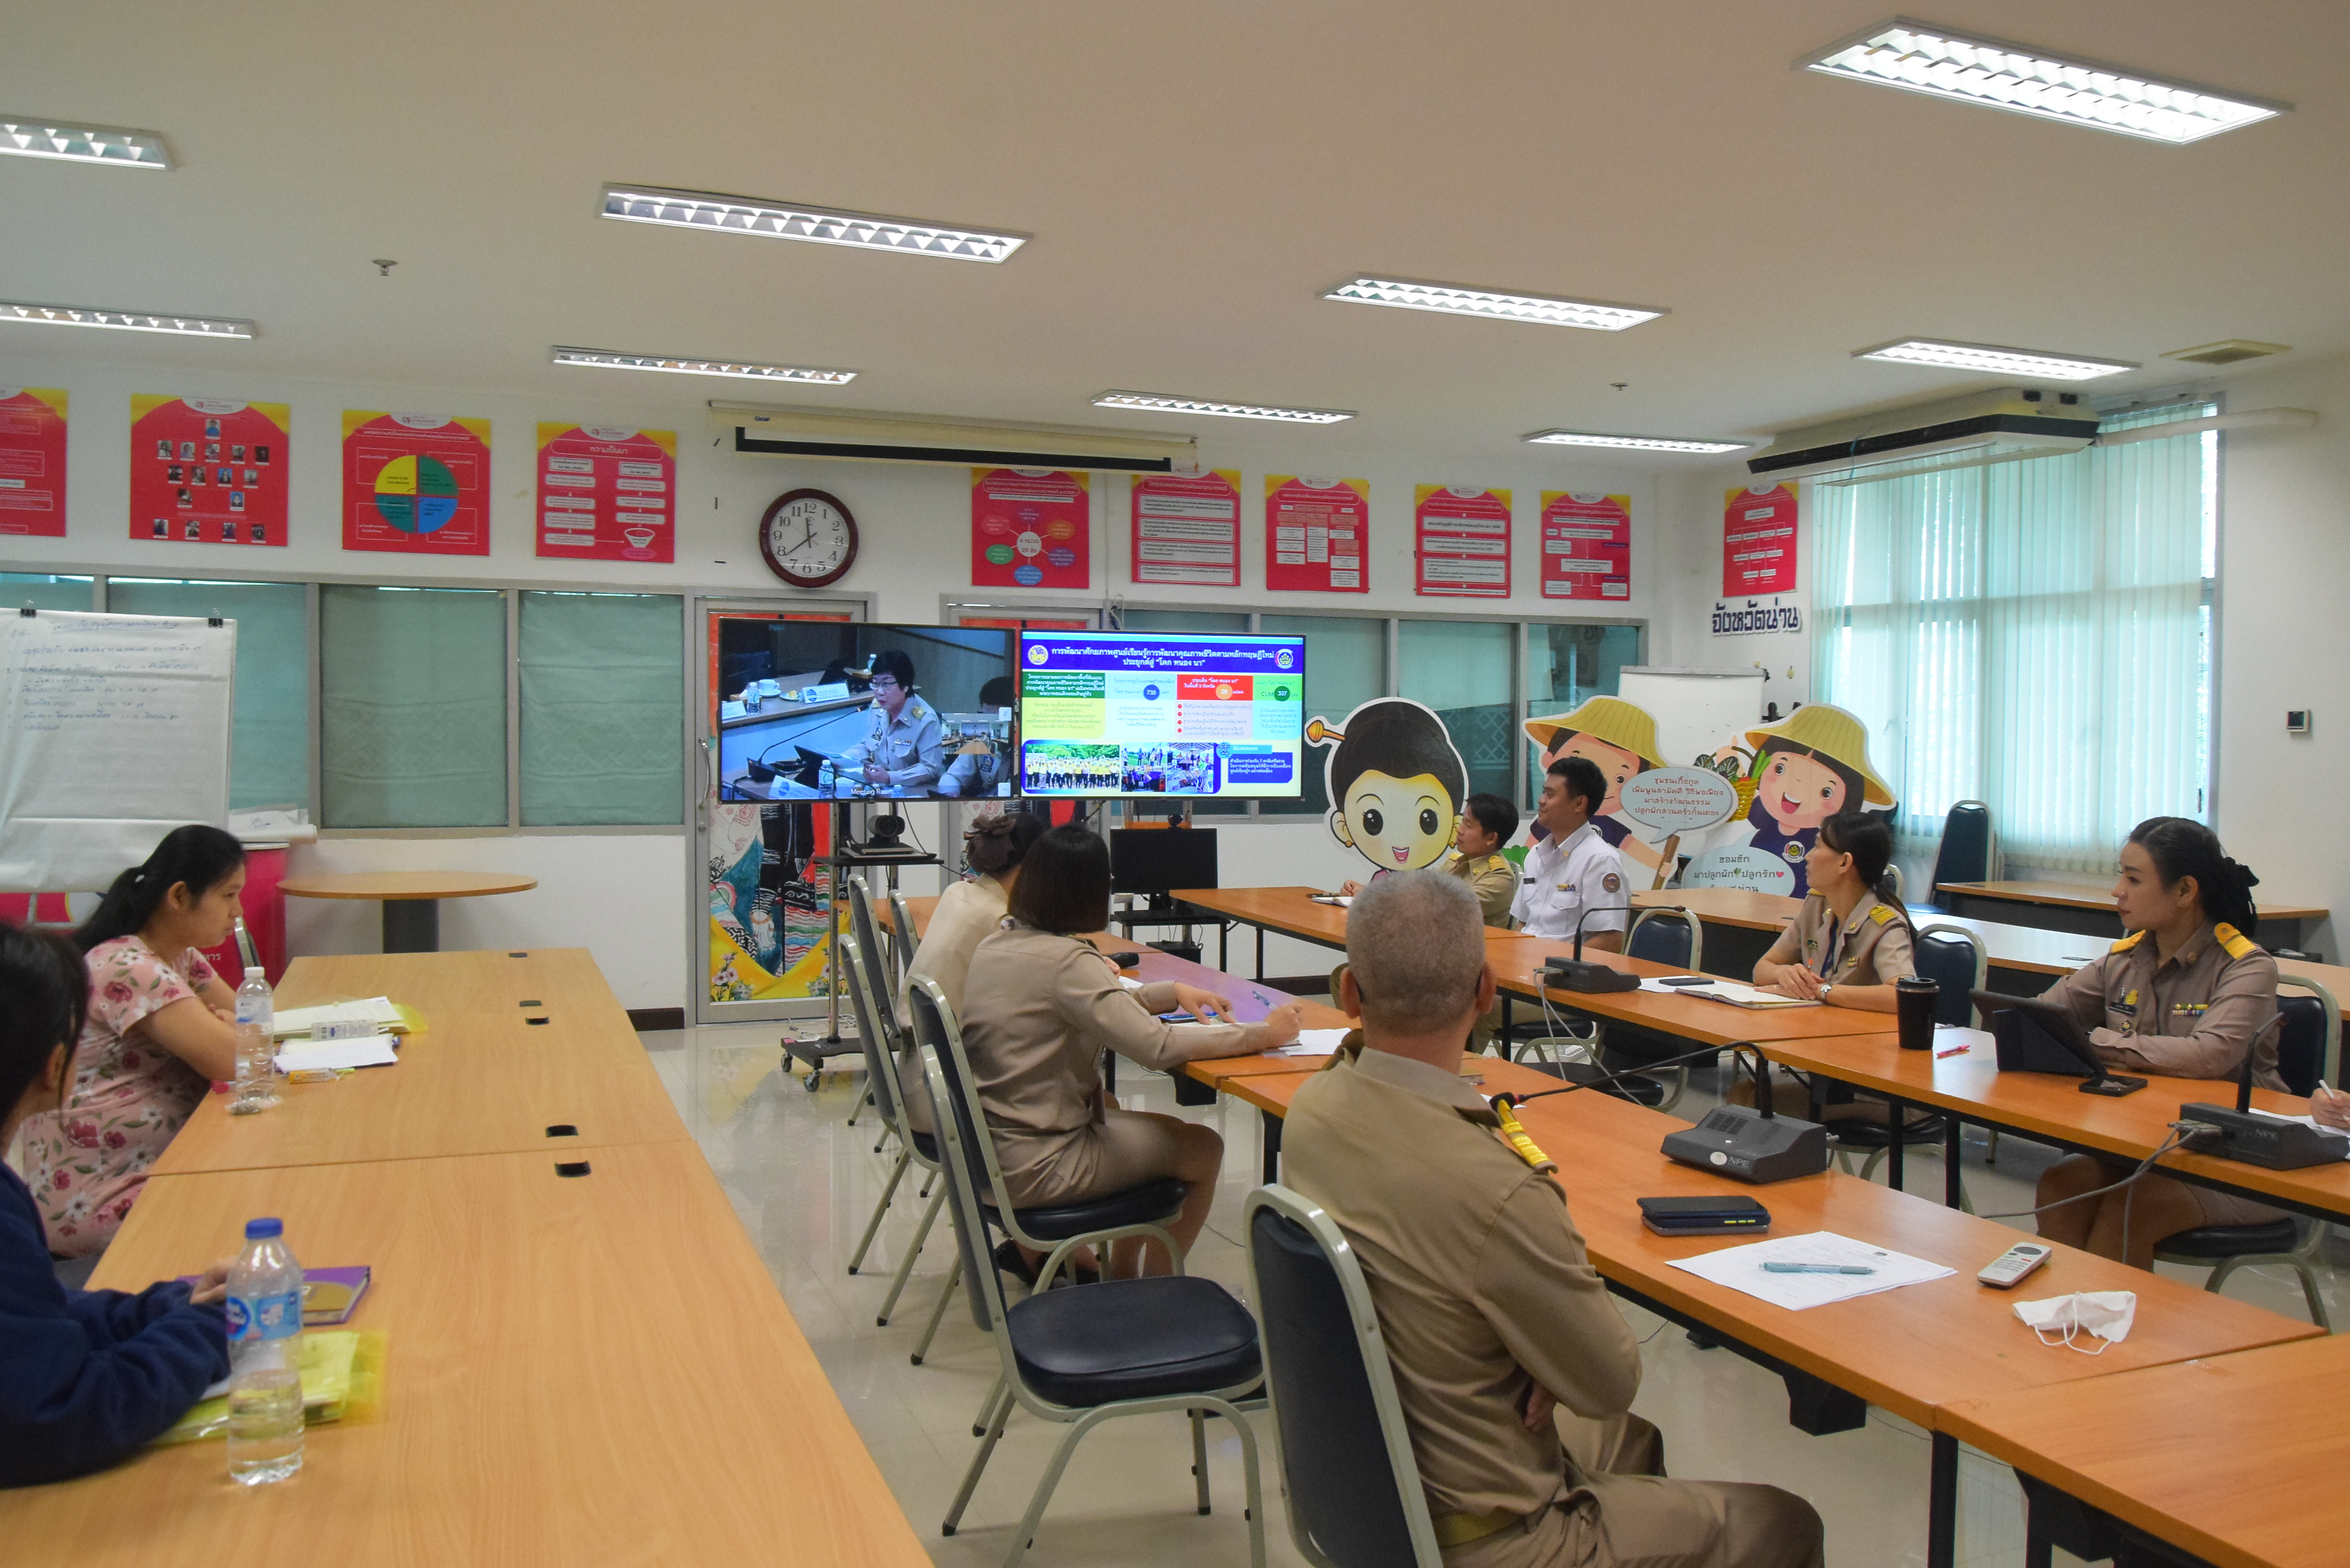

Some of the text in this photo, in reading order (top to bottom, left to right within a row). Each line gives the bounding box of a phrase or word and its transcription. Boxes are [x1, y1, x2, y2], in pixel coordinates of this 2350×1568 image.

[791, 506, 801, 517] 11
[804, 503, 816, 513] 12
[823, 509, 827, 519] 1
[778, 516, 790, 526] 10
[832, 521, 840, 531] 2
[773, 531, 782, 540] 9
[836, 536, 844, 546] 3
[777, 546, 786, 556] 8
[828, 551, 836, 561] 4
[790, 559, 798, 569] 7
[803, 563, 812, 573] 6
[817, 561, 826, 571] 5
[1712, 596, 1799, 633] จังหวัดน่าน
[1052, 646, 1274, 660] การพัฒนาศักยภาพศูนย์เรียนรู้การพัฒนาคุณภาพชีวิตตามหลักทฤษฎีใหม่
[1123, 657, 1154, 667] ประยุกต์สู่
[1654, 775, 1699, 787] ชุมชนเกื้อกูล
[1644, 796, 1710, 805] มาสร้างวัฒนธรรม
[1694, 869, 1776, 880] มาปลูกผัก ปลูกรัก
[1727, 1156, 1750, 1168] NPE
